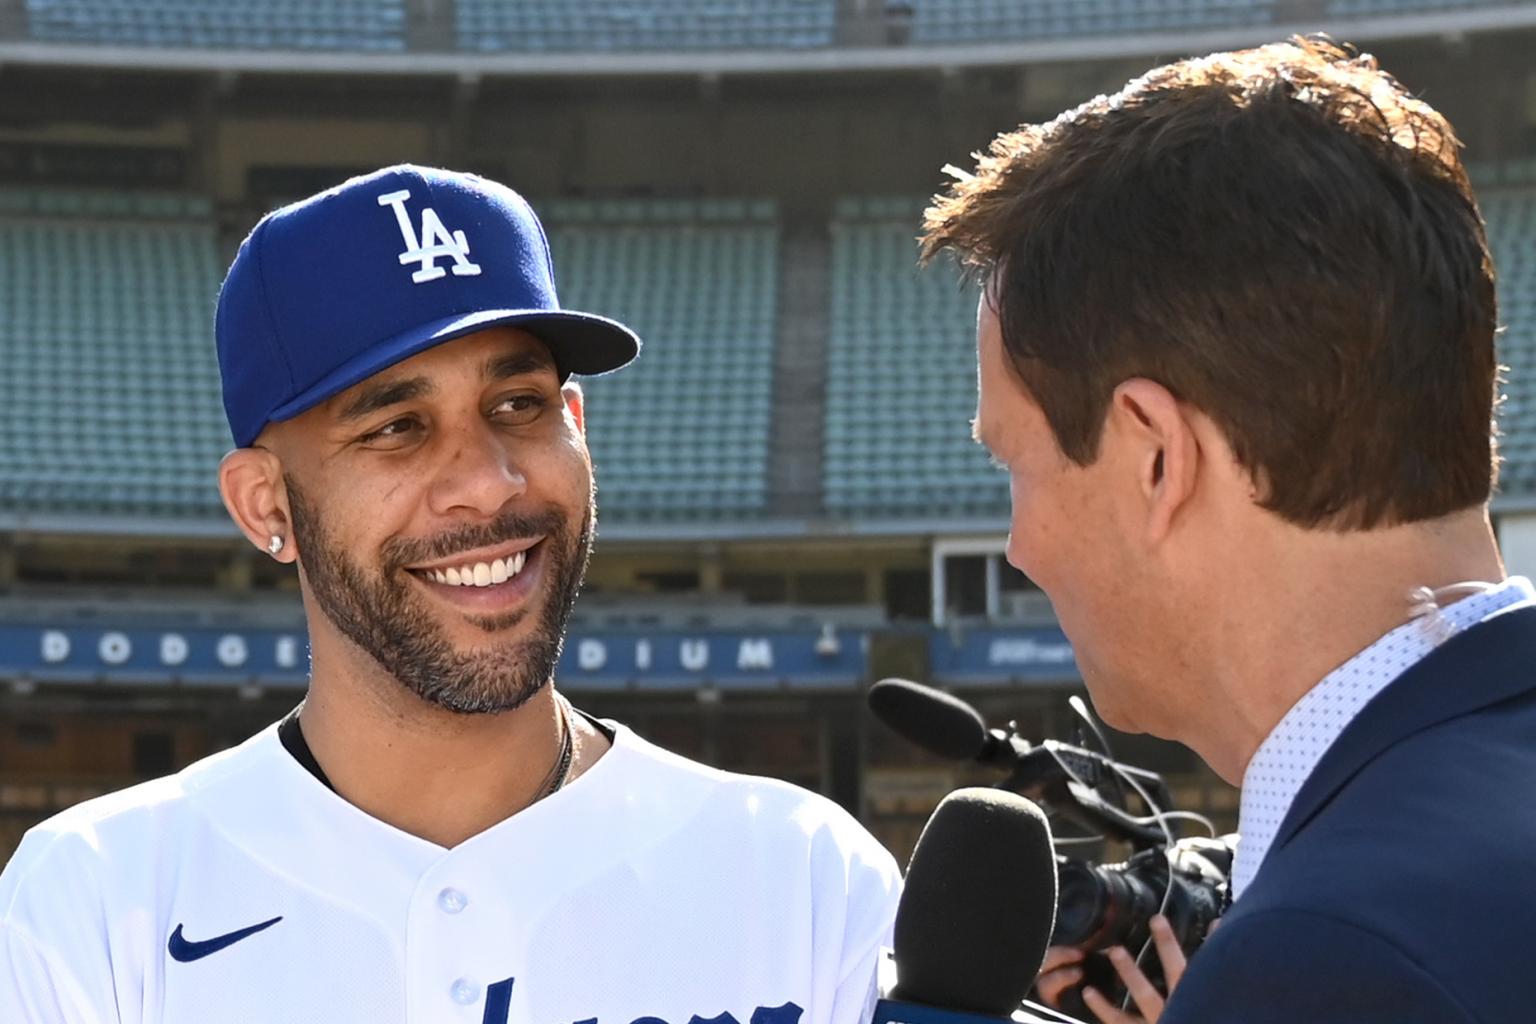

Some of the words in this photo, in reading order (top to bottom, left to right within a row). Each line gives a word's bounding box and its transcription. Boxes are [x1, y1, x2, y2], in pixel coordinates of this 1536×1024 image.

[377, 189, 482, 284] LA
[42, 630, 298, 668] DODGE
[577, 637, 774, 671] DIUM
